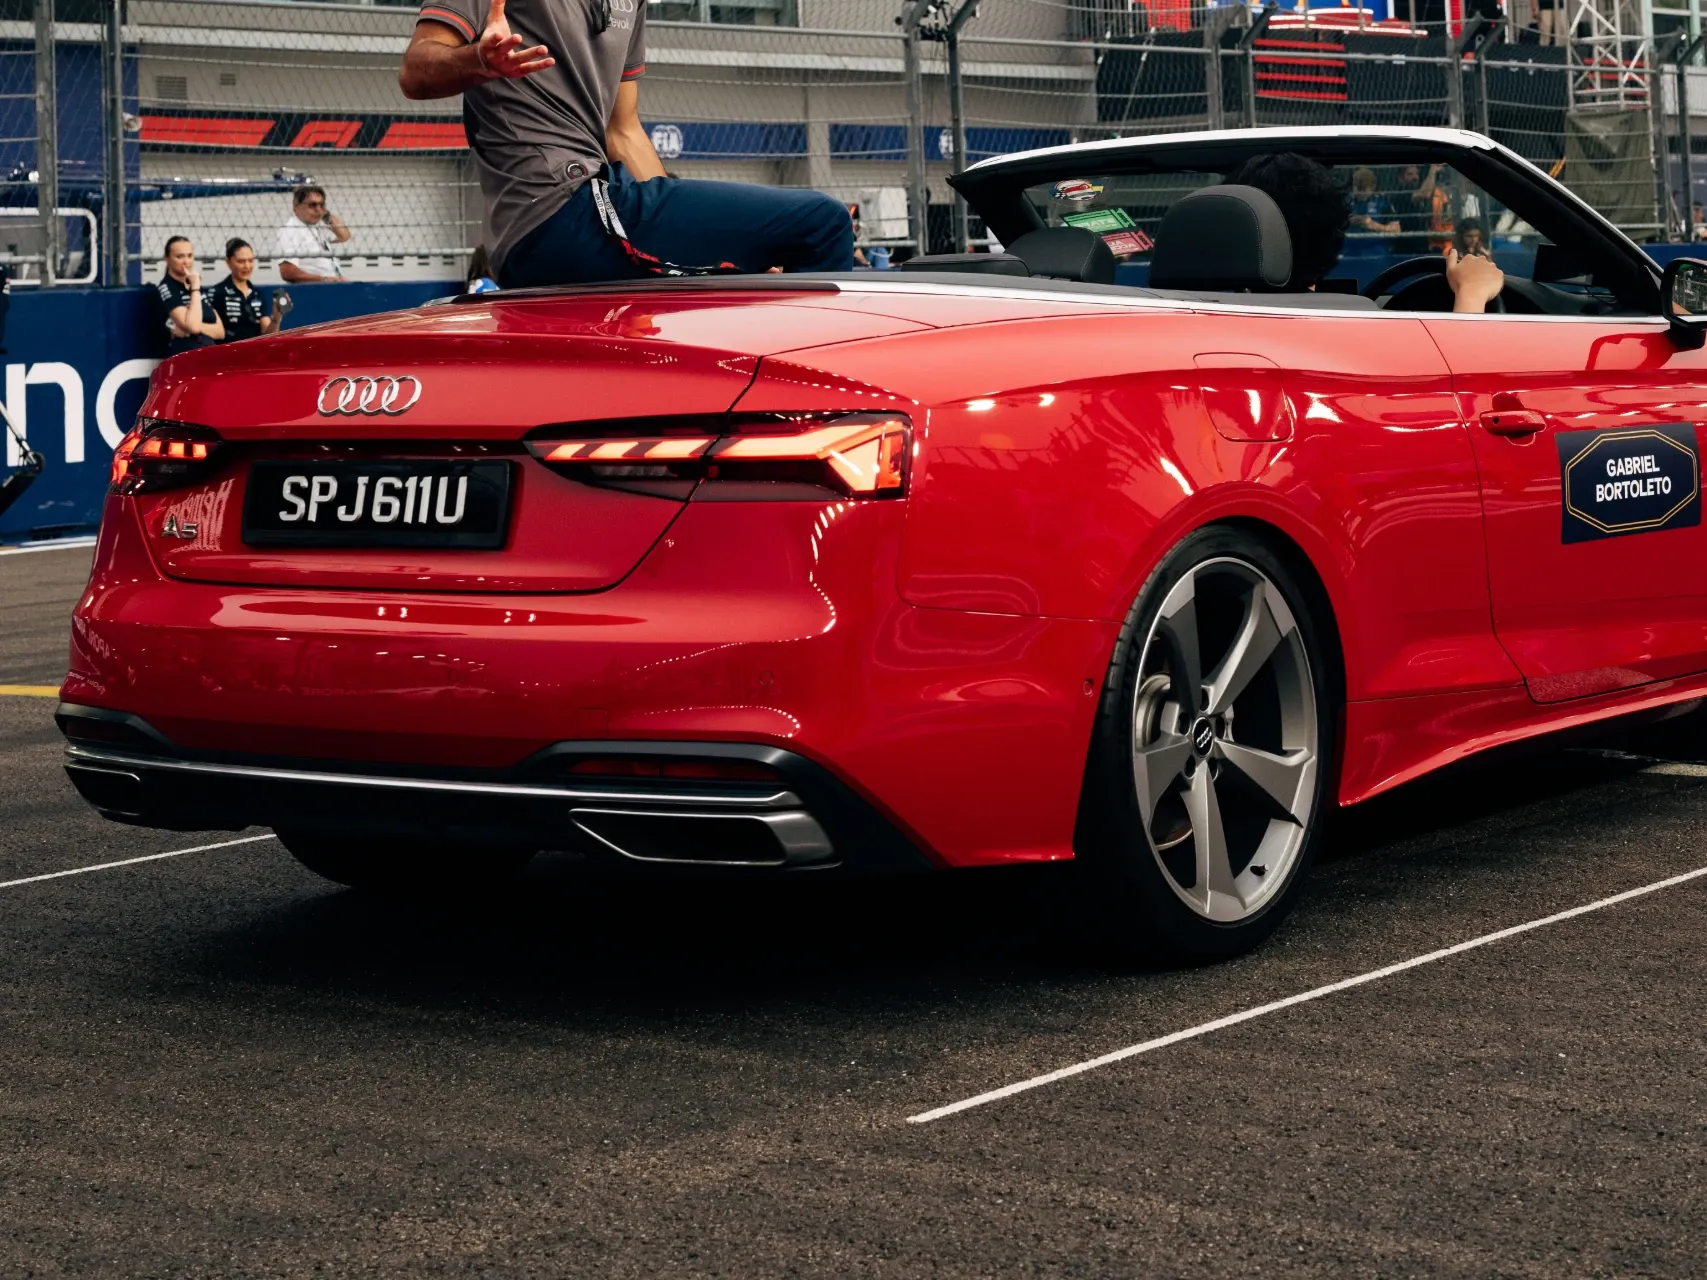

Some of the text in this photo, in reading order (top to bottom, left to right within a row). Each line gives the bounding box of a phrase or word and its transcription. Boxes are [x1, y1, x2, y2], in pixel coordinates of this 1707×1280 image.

[1606, 455, 1660, 477] GABRIEL
[1595, 476, 1672, 502] BORTOLETO
[160, 515, 198, 539] A5
